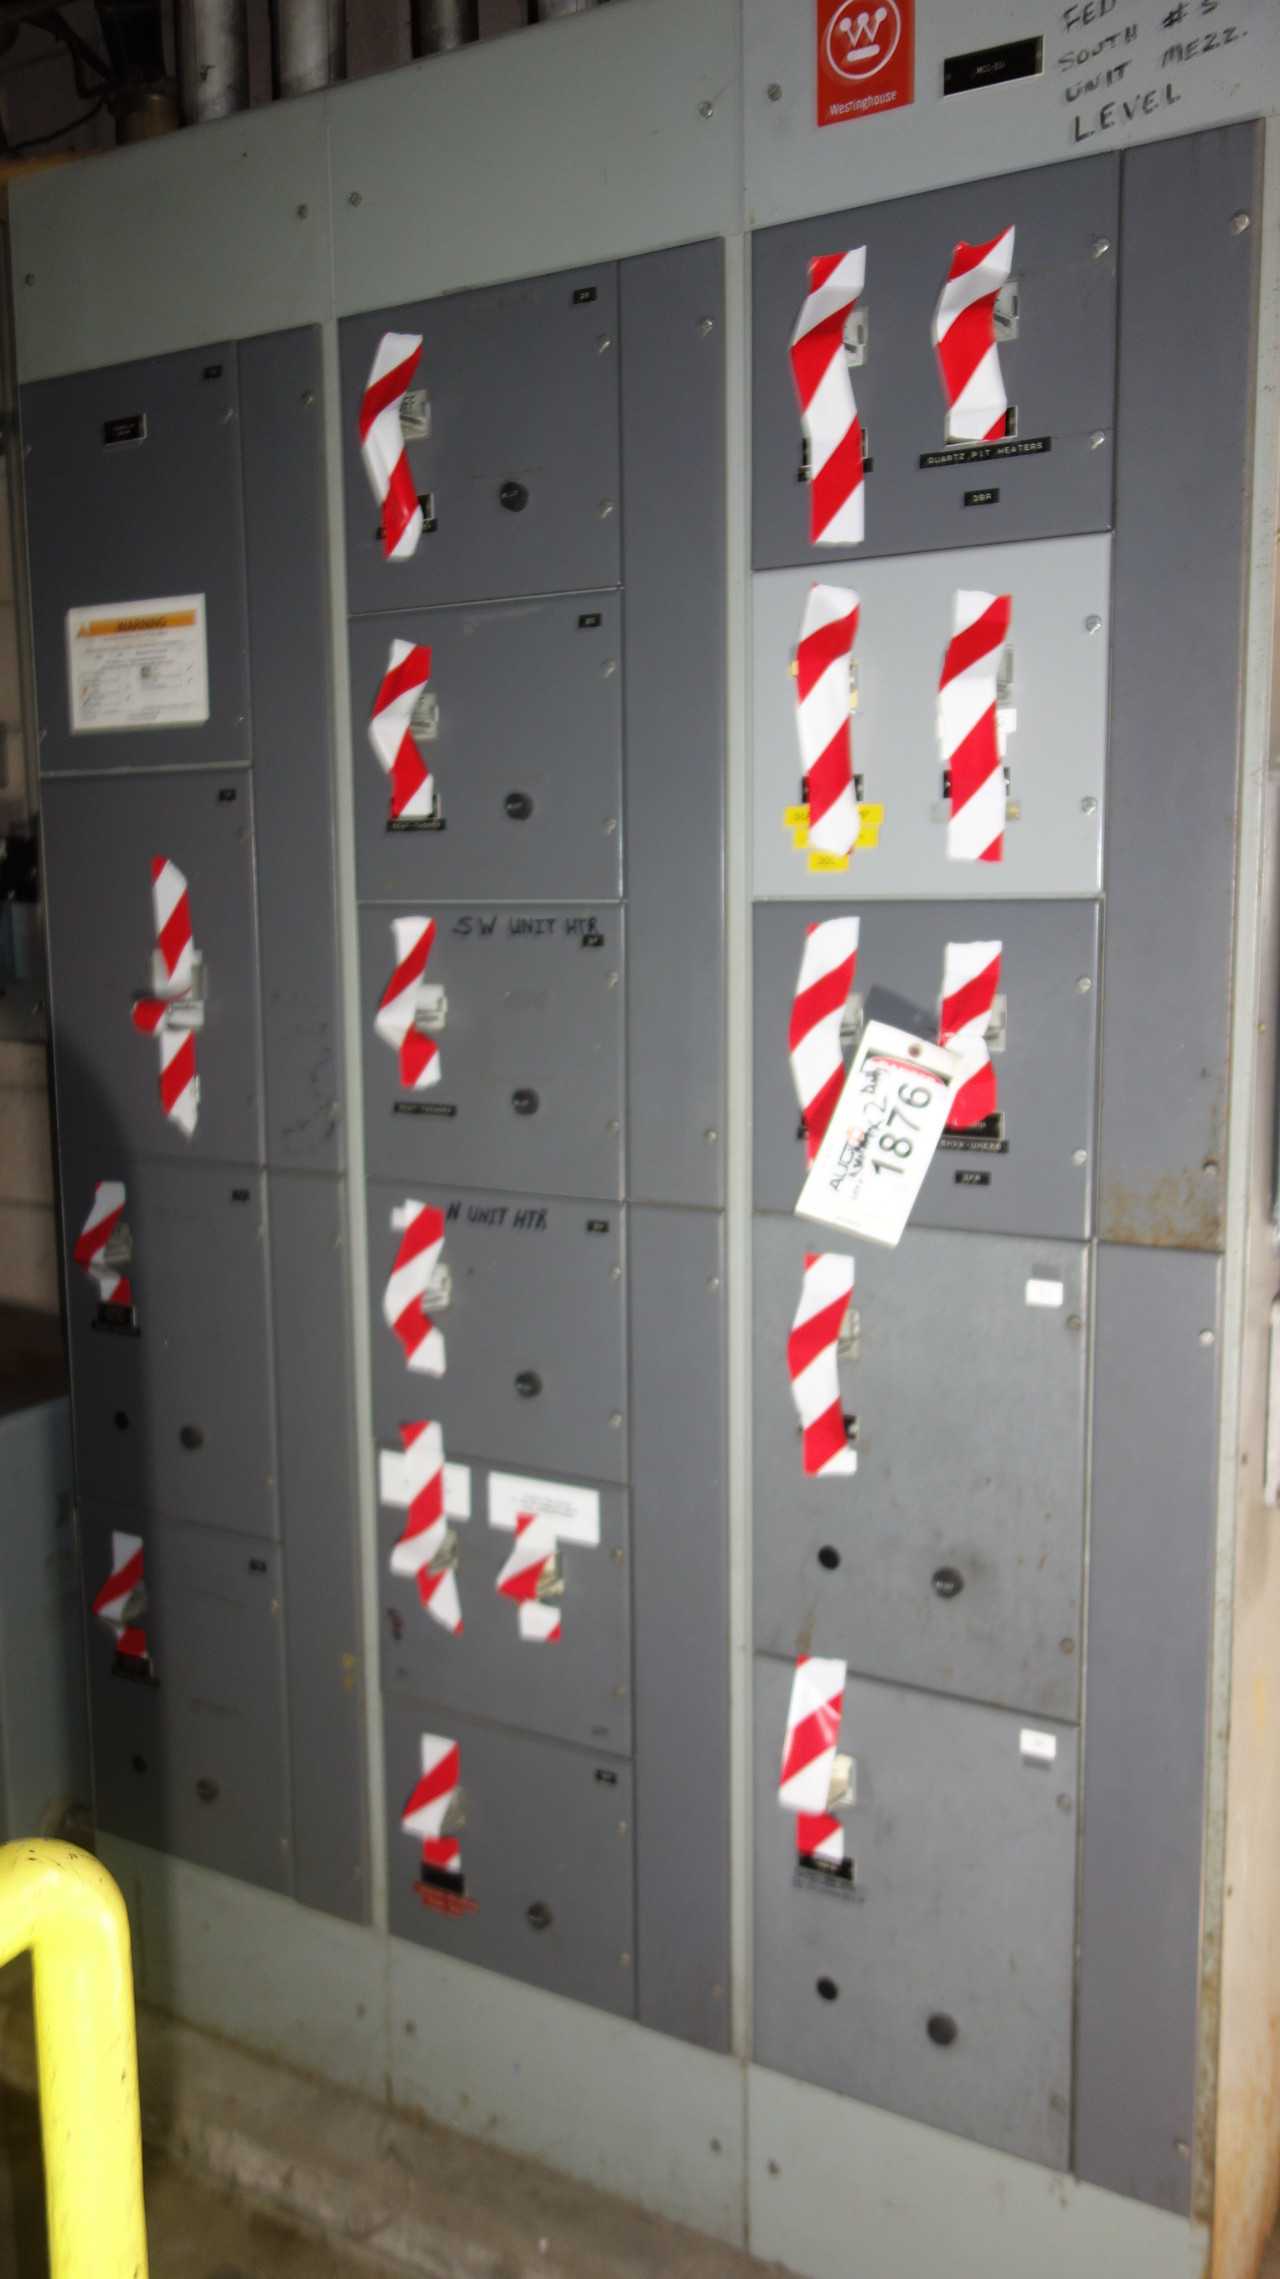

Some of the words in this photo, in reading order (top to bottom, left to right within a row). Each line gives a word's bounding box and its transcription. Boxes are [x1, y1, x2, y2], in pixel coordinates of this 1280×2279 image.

[1057, 24, 1138, 72] SOUTH
[1064, 59, 1133, 103] UNIT
[829, 90, 897, 116] Westinghouse
[1074, 83, 1181, 143] LEVEL
[927, 452, 965, 465] QUARTZ
[998, 441, 1044, 454] HEATERS
[509, 918, 555, 934] UNIT
[871, 1082, 932, 1176] 1876
[467, 1205, 506, 1226] UNIT
